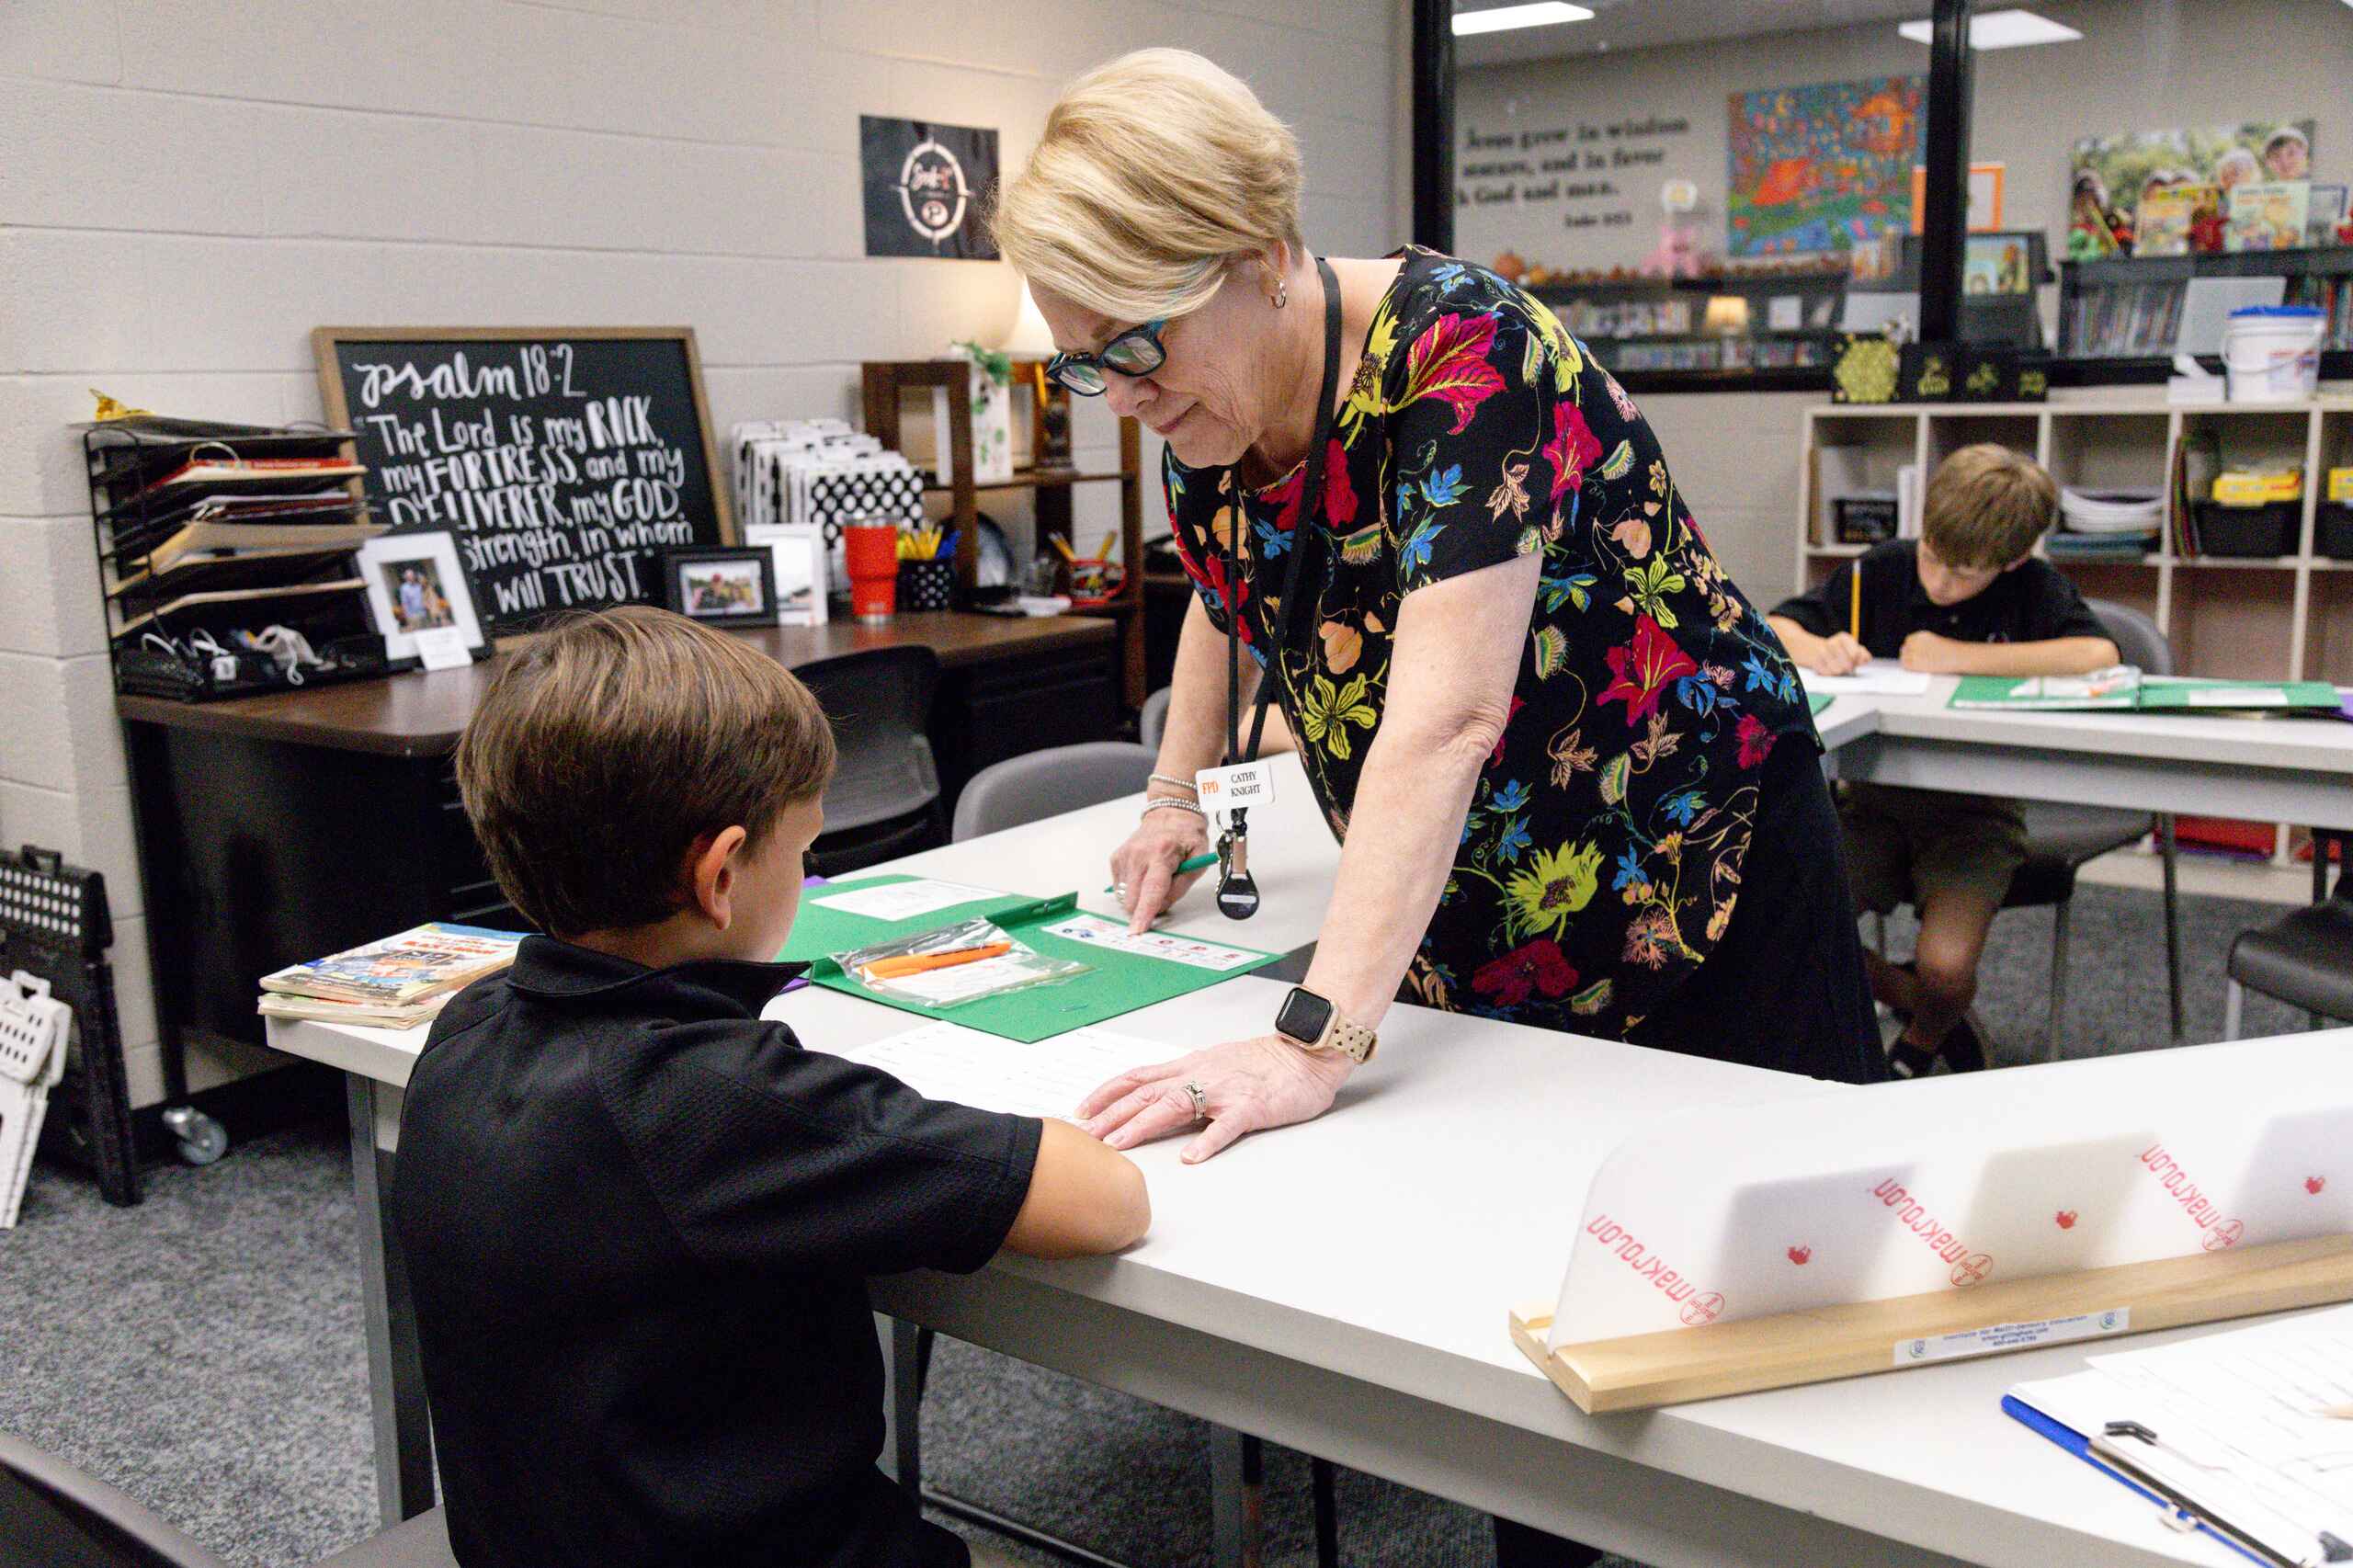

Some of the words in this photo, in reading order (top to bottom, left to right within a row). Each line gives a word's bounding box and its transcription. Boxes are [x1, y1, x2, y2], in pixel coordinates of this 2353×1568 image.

[520, 343, 588, 398] 18:2
[431, 407, 497, 453] Lord
[510, 415, 534, 448] is
[543, 416, 587, 454] my
[381, 464, 426, 510] my
[585, 449, 629, 480] and
[637, 448, 685, 489] my
[570, 490, 616, 529] my
[579, 526, 610, 556] in
[614, 520, 693, 548] whom
[1201, 781, 1220, 795] FPD
[1230, 770, 1257, 785] CATHY
[1230, 784, 1262, 798] KNIGHT
[1874, 1176, 1969, 1264] makrolon
[1586, 1214, 1697, 1302] makrolon
